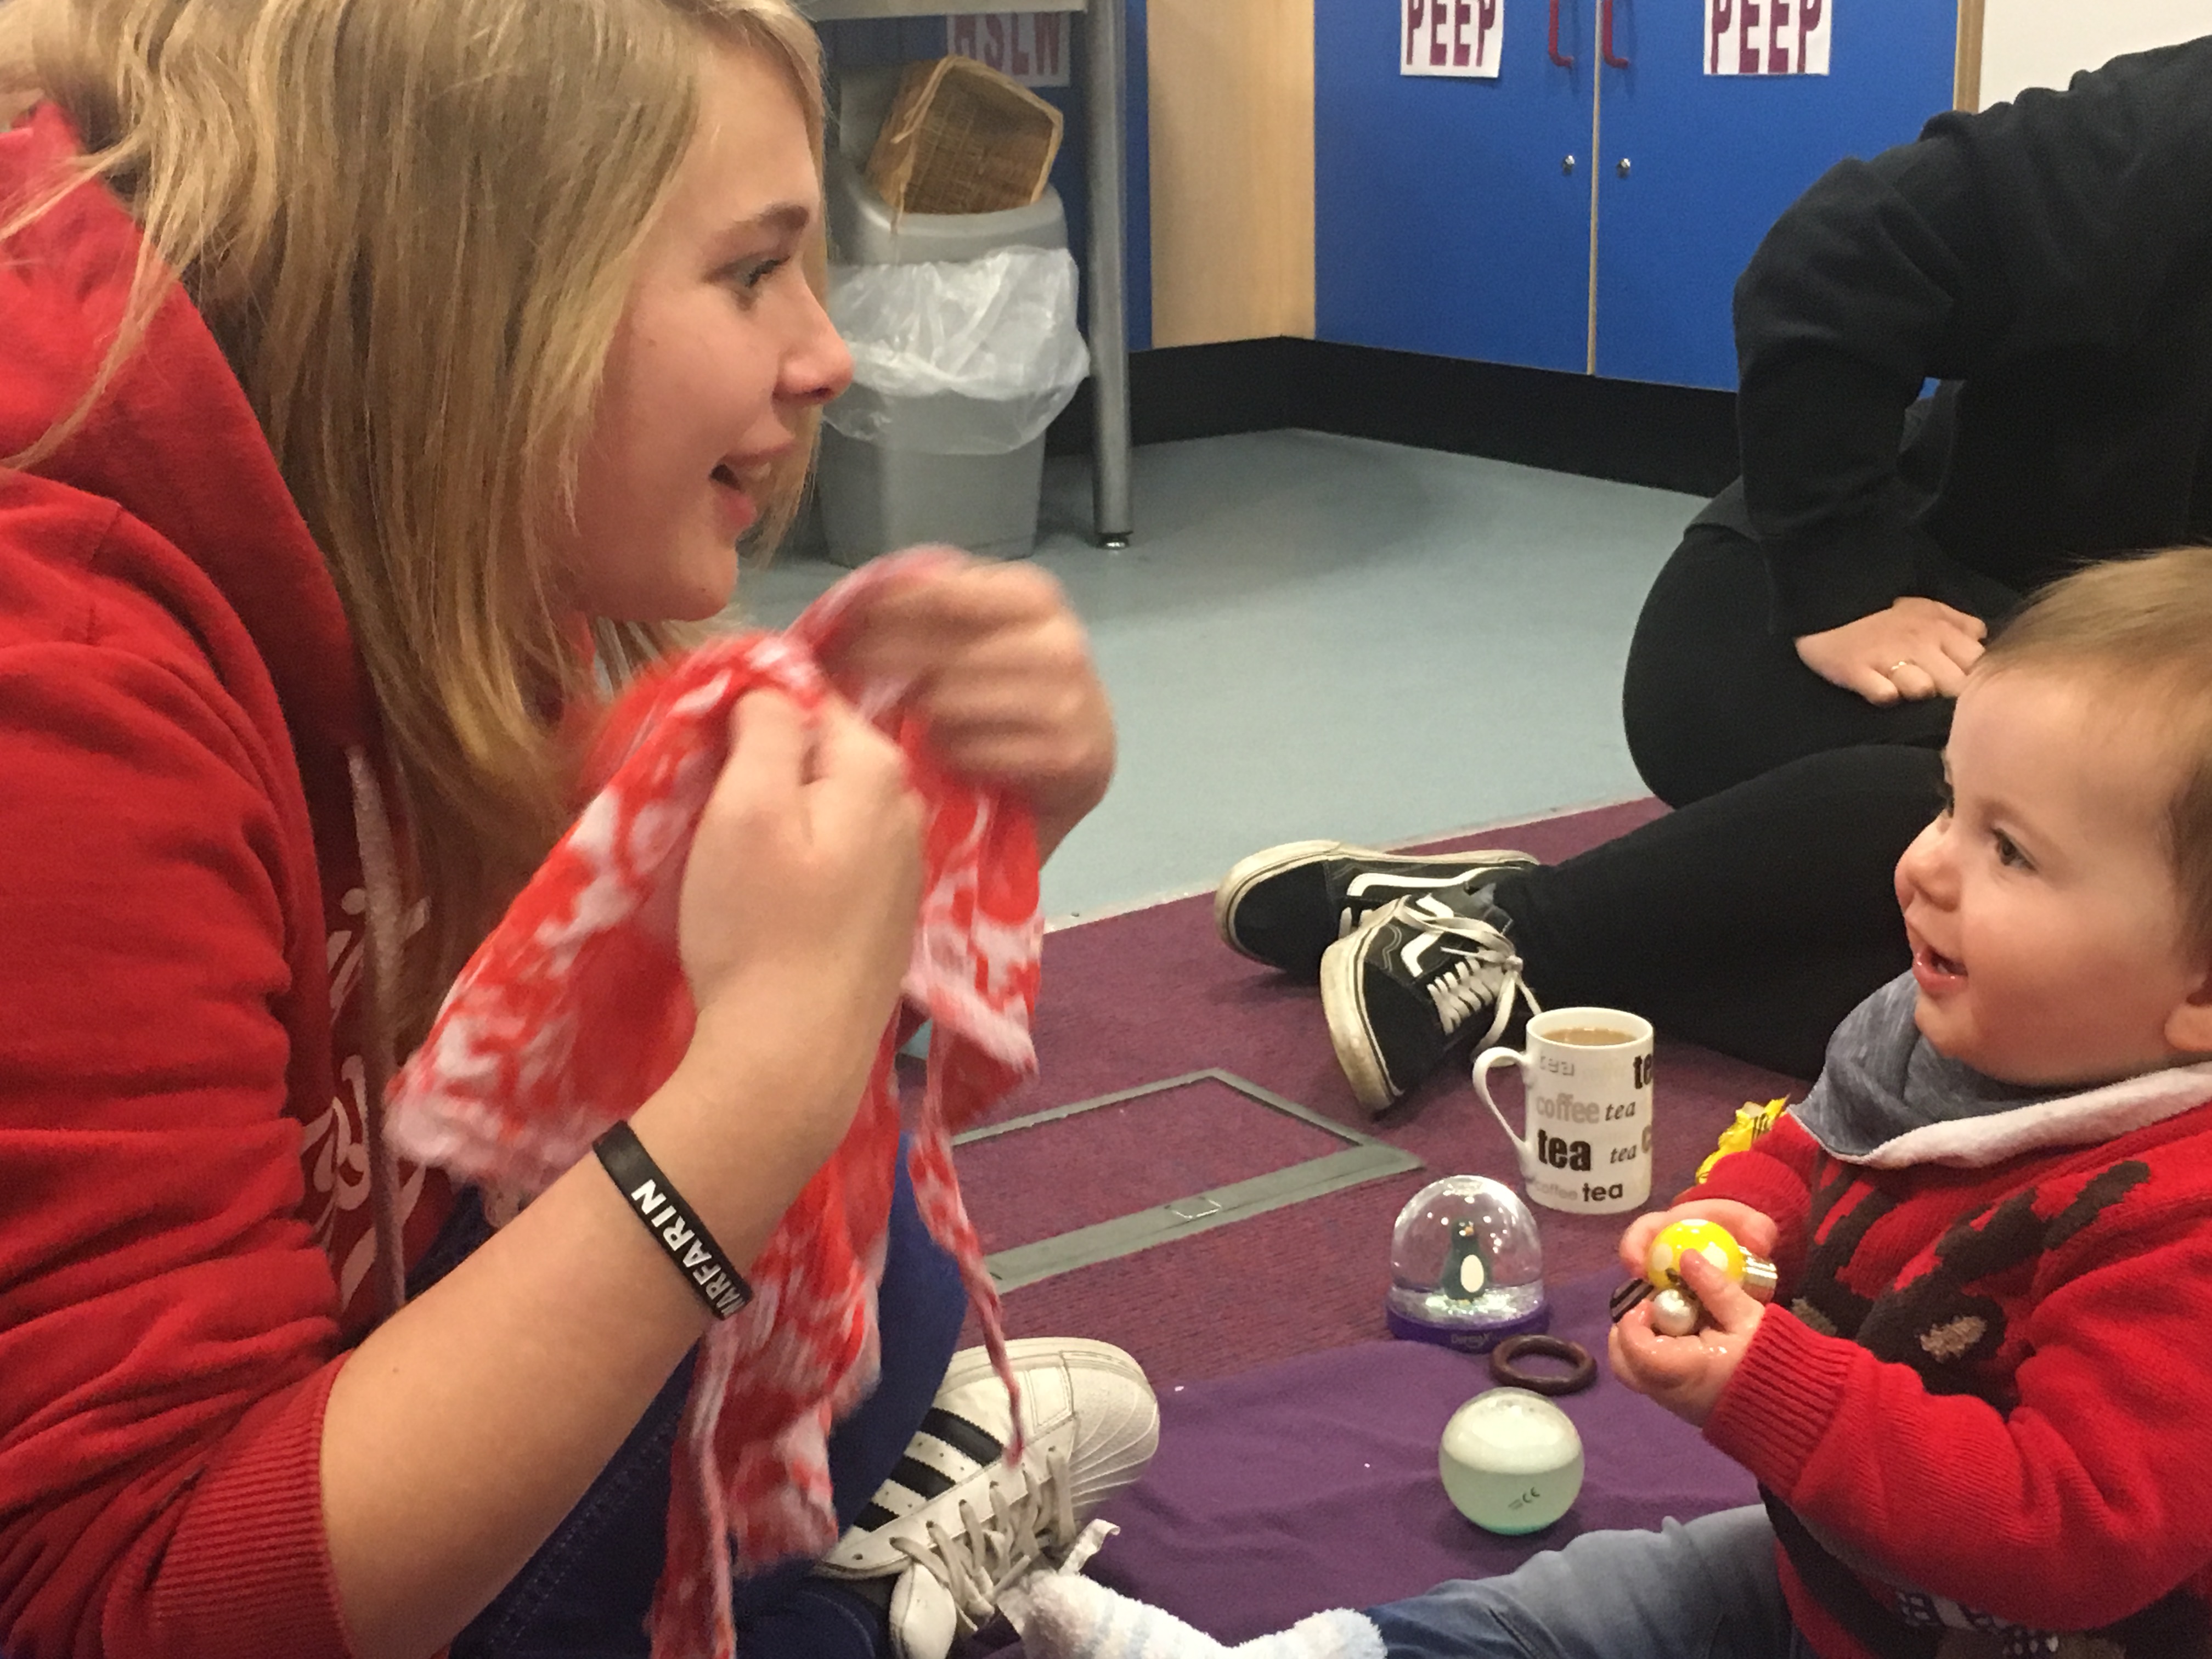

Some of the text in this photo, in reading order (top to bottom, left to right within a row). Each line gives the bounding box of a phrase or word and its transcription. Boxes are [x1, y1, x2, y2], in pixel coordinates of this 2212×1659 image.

[1407, 0, 1496, 66] PEEP
[1711, 0, 1822, 73] PEEP
[1537, 1093, 1636, 1124] coffee tea
[1538, 1128, 1591, 1171] tea
[1610, 1144, 1637, 1164] tea
[1534, 1181, 1623, 1202] coffee tea
